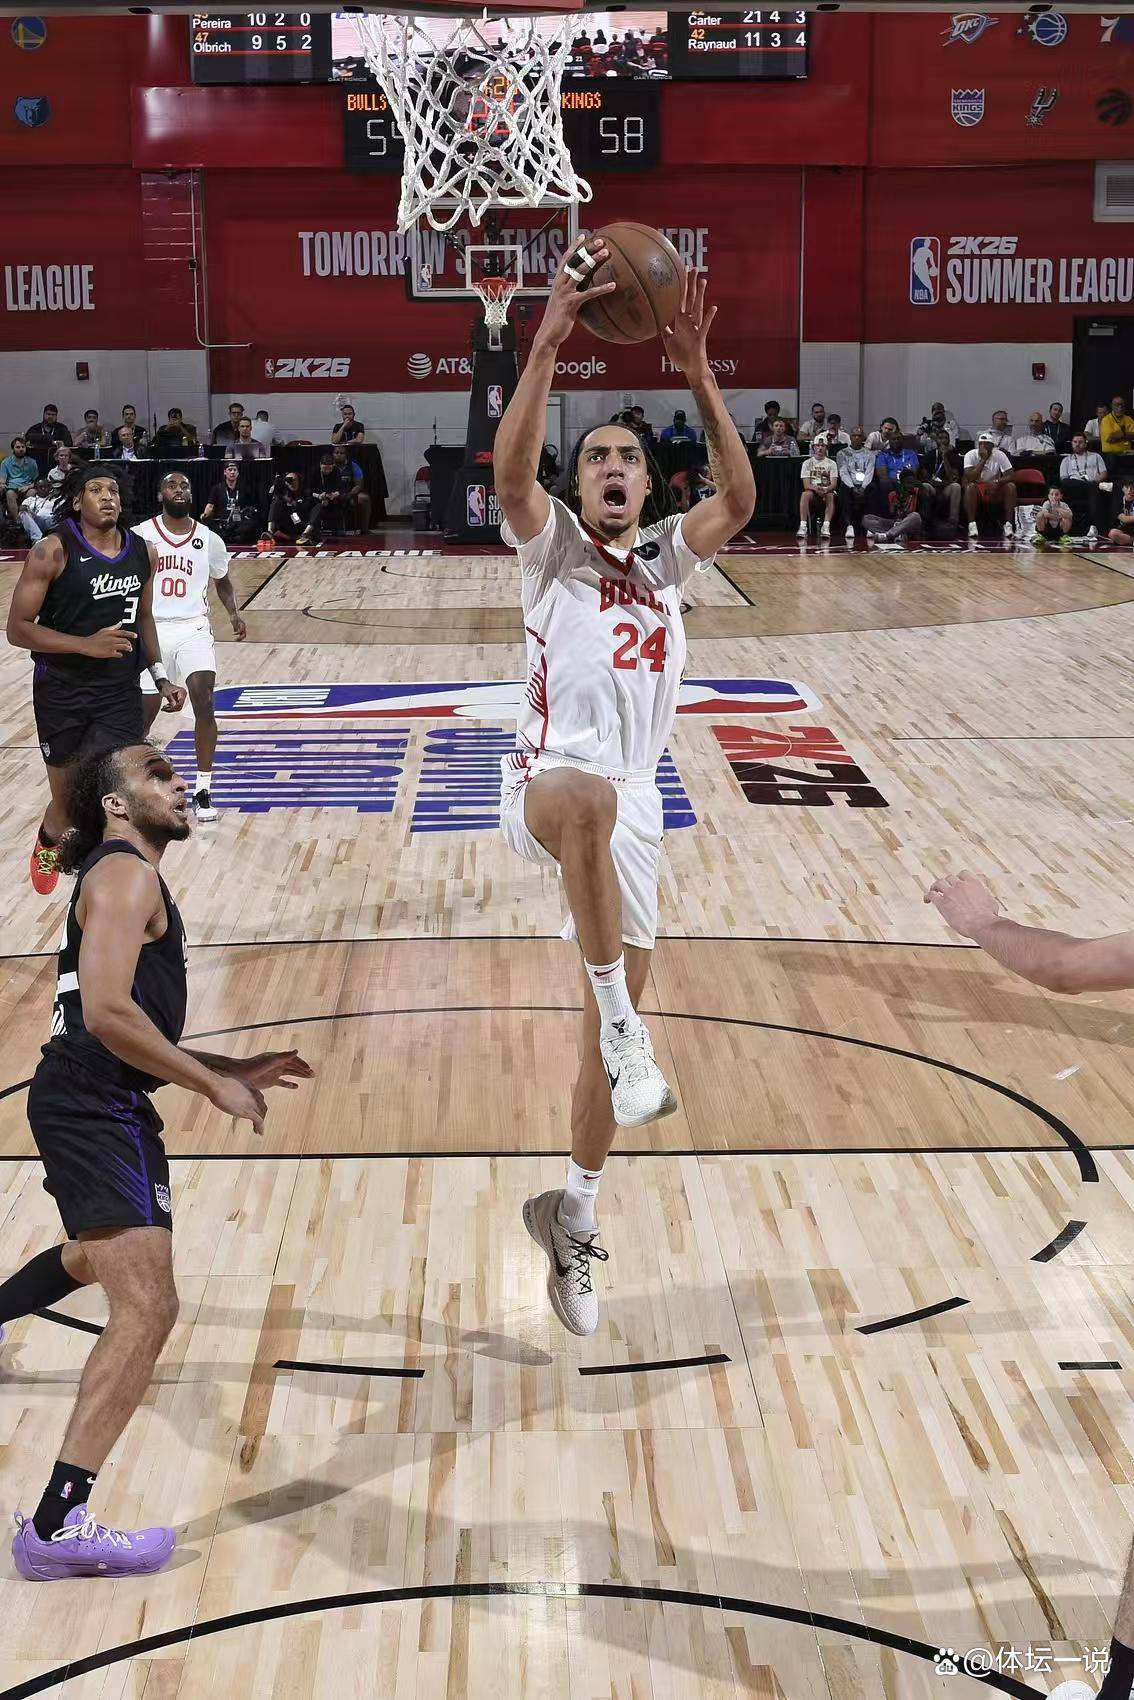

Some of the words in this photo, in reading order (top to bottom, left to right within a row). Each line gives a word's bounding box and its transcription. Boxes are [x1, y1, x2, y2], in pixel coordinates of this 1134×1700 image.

[192, 18, 232, 29] Pereira
[247, 13, 267, 26] 10
[274, 13, 285, 26] 2
[300, 13, 311, 27] 0
[688, 15, 722, 26] Carter
[743, 10, 761, 23] 21
[769, 10, 780, 23] 4
[795, 10, 806, 24] 3
[193, 42, 232, 53] Olbrich
[251, 35, 262, 50] 9
[276, 35, 287, 51] 5
[301, 34, 312, 50] 2
[195, 32, 209, 43] 47
[688, 39, 737, 52] Raynaud
[744, 31, 761, 47] 11
[770, 32, 781, 47] 3
[795, 31, 806, 47] 4
[690, 29, 705, 39] 42
[347, 94, 387, 111] BULLS
[561, 92, 602, 109] KINGS
[952, 103, 984, 113] KINGS
[599, 116, 644, 154] 58
[947, 236, 1019, 255] 2K26
[5, 264, 96, 311] LEAGUE
[946, 258, 1054, 304] SUMMER
[914, 289, 929, 300] NBA
[274, 357, 351, 379] 2K26
[555, 355, 608, 379] oogle
[661, 355, 739, 376] Heessy
[294, 549, 443, 559] LEAGUE
[156, 554, 194, 577] BULLS
[90, 572, 142, 600] Kings
[161, 577, 187, 598] 00
[122, 596, 139, 625] 3
[612, 622, 667, 673] 24
[710, 725, 890, 808] 2K26
